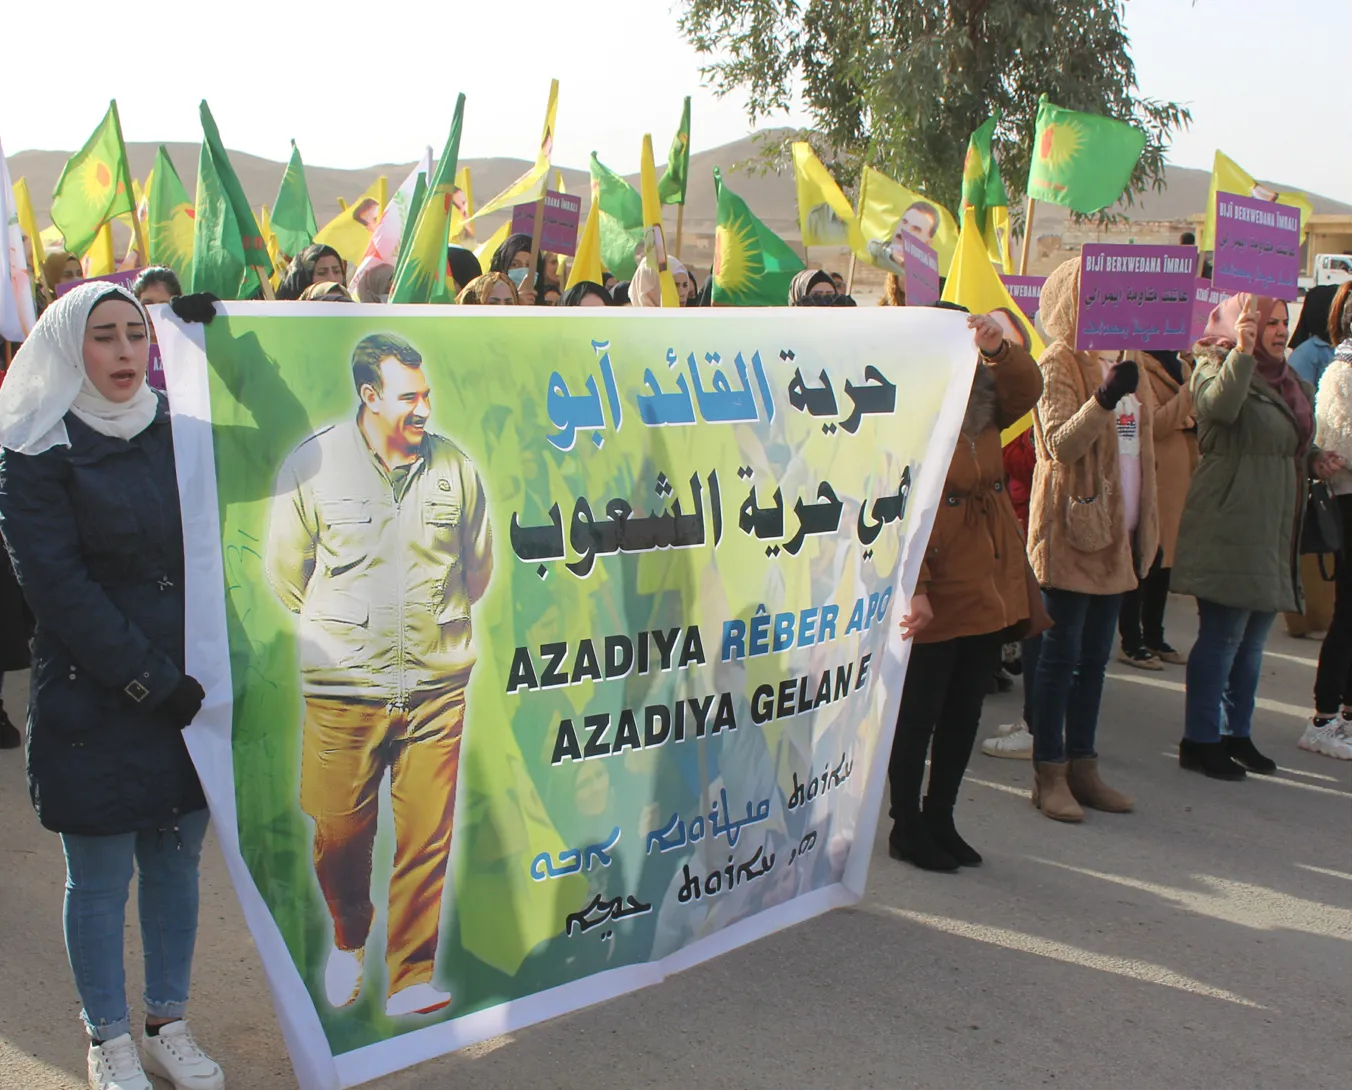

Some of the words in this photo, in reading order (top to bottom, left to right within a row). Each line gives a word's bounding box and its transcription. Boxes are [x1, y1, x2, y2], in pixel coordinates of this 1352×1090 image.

[1220, 202, 1233, 218] BIJÎ
[1005, 284, 1041, 298] RXWEDANA
[1086, 253, 1104, 272] BIJÎ
[1106, 256, 1160, 273] BERXWEDANA
[1163, 254, 1192, 273] ÎMRALI
[546, 339, 623, 451] آبو
[637, 347, 775, 427] القائد
[779, 349, 897, 435] حرية
[509, 468, 723, 579] الشعوب
[738, 465, 844, 559] حرية
[857, 465, 911, 561] في
[506, 625, 706, 694] AZADIYA
[721, 604, 839, 663] RÊBER
[844, 585, 893, 636] APO
[550, 692, 737, 766] AZADIYA
